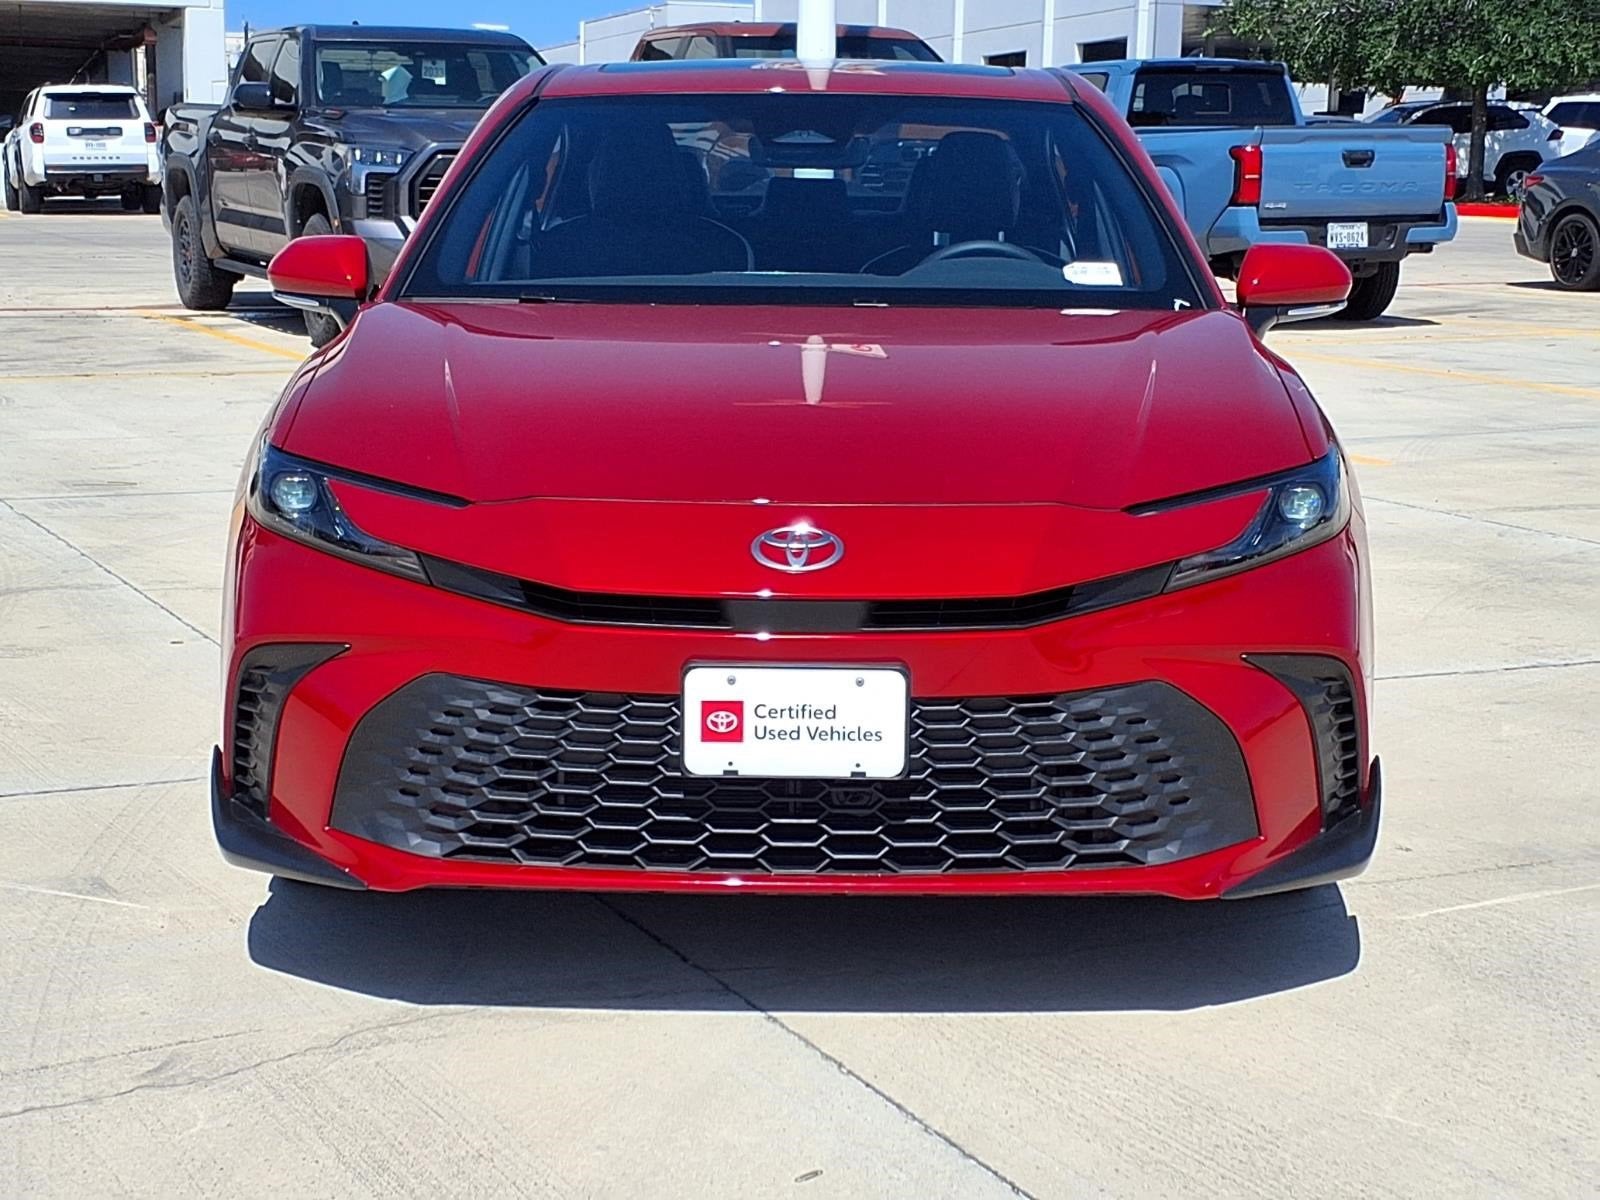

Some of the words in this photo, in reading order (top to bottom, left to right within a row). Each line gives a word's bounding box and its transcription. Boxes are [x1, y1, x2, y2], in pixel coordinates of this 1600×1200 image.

[1293, 180, 1420, 194] TACOMA
[754, 703, 837, 720] Certified
[754, 725, 801, 741] Used
[806, 725, 883, 742] Vehicles
